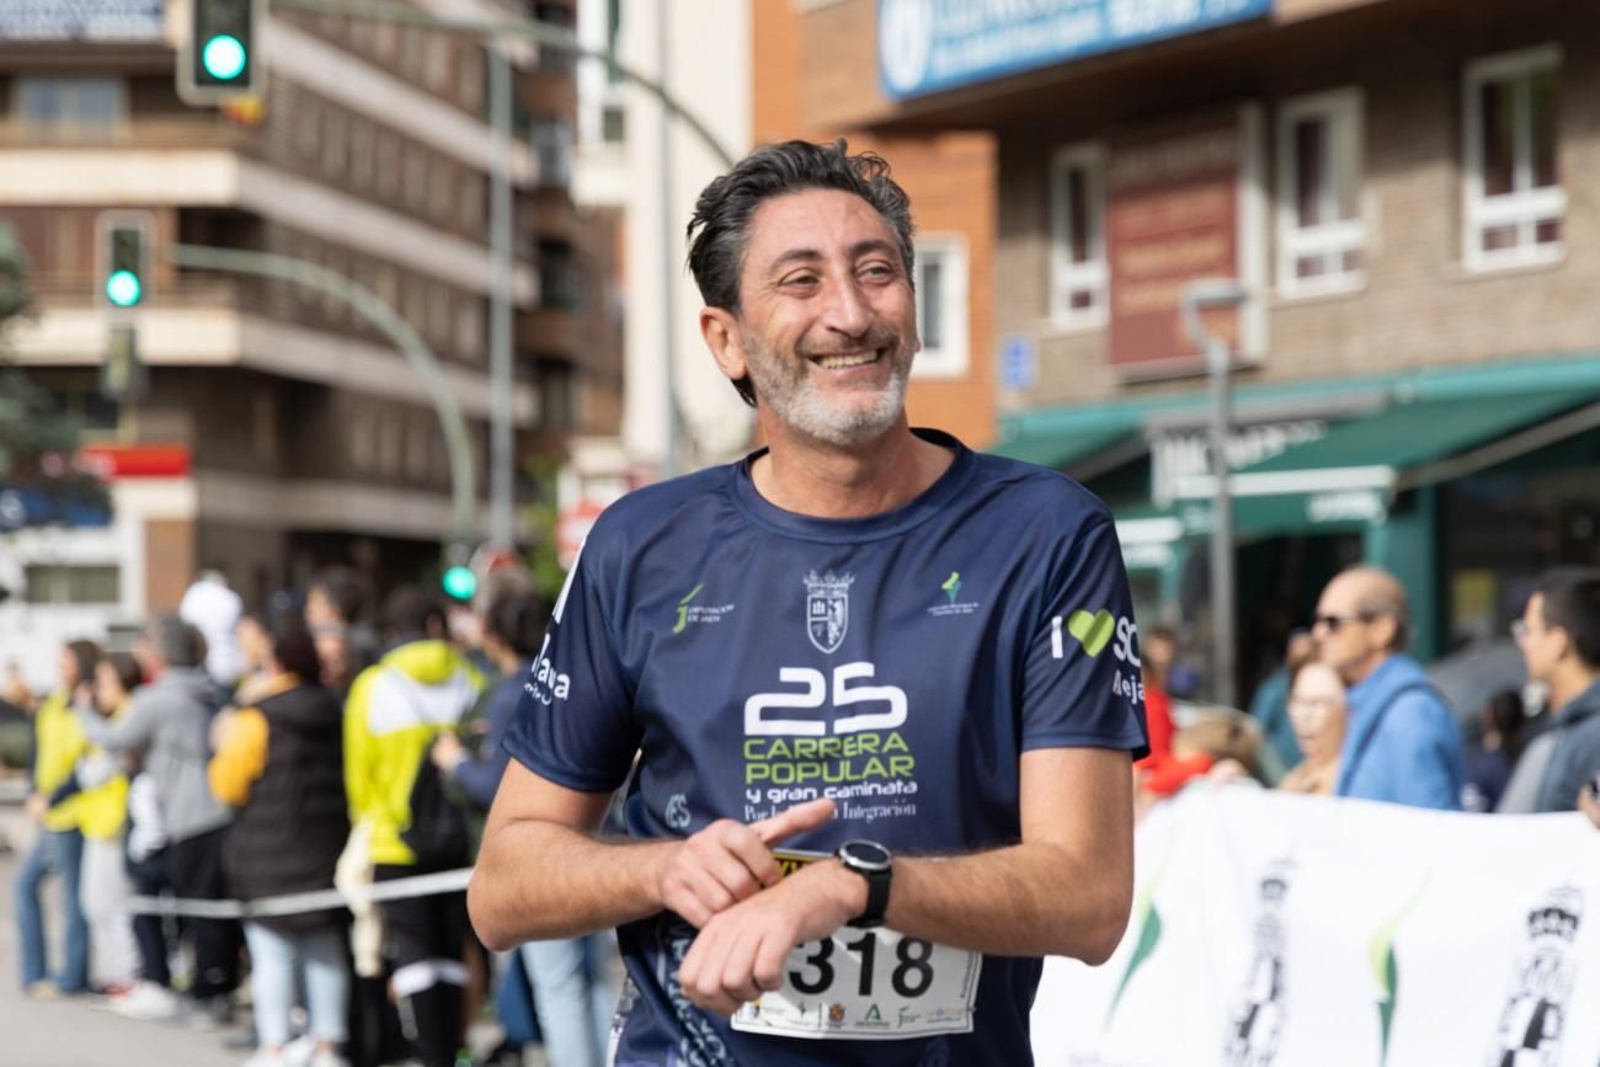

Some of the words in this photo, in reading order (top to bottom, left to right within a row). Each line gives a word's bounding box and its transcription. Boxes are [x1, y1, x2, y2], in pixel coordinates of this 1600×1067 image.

[1050, 615, 1064, 659] I
[744, 661, 908, 736] 25
[743, 732, 909, 760] CARRERA
[745, 755, 915, 785] POPULAR
[746, 788, 761, 804] y
[766, 785, 818, 804] gran
[823, 779, 918, 800] caminata
[788, 931, 935, 998] 318
